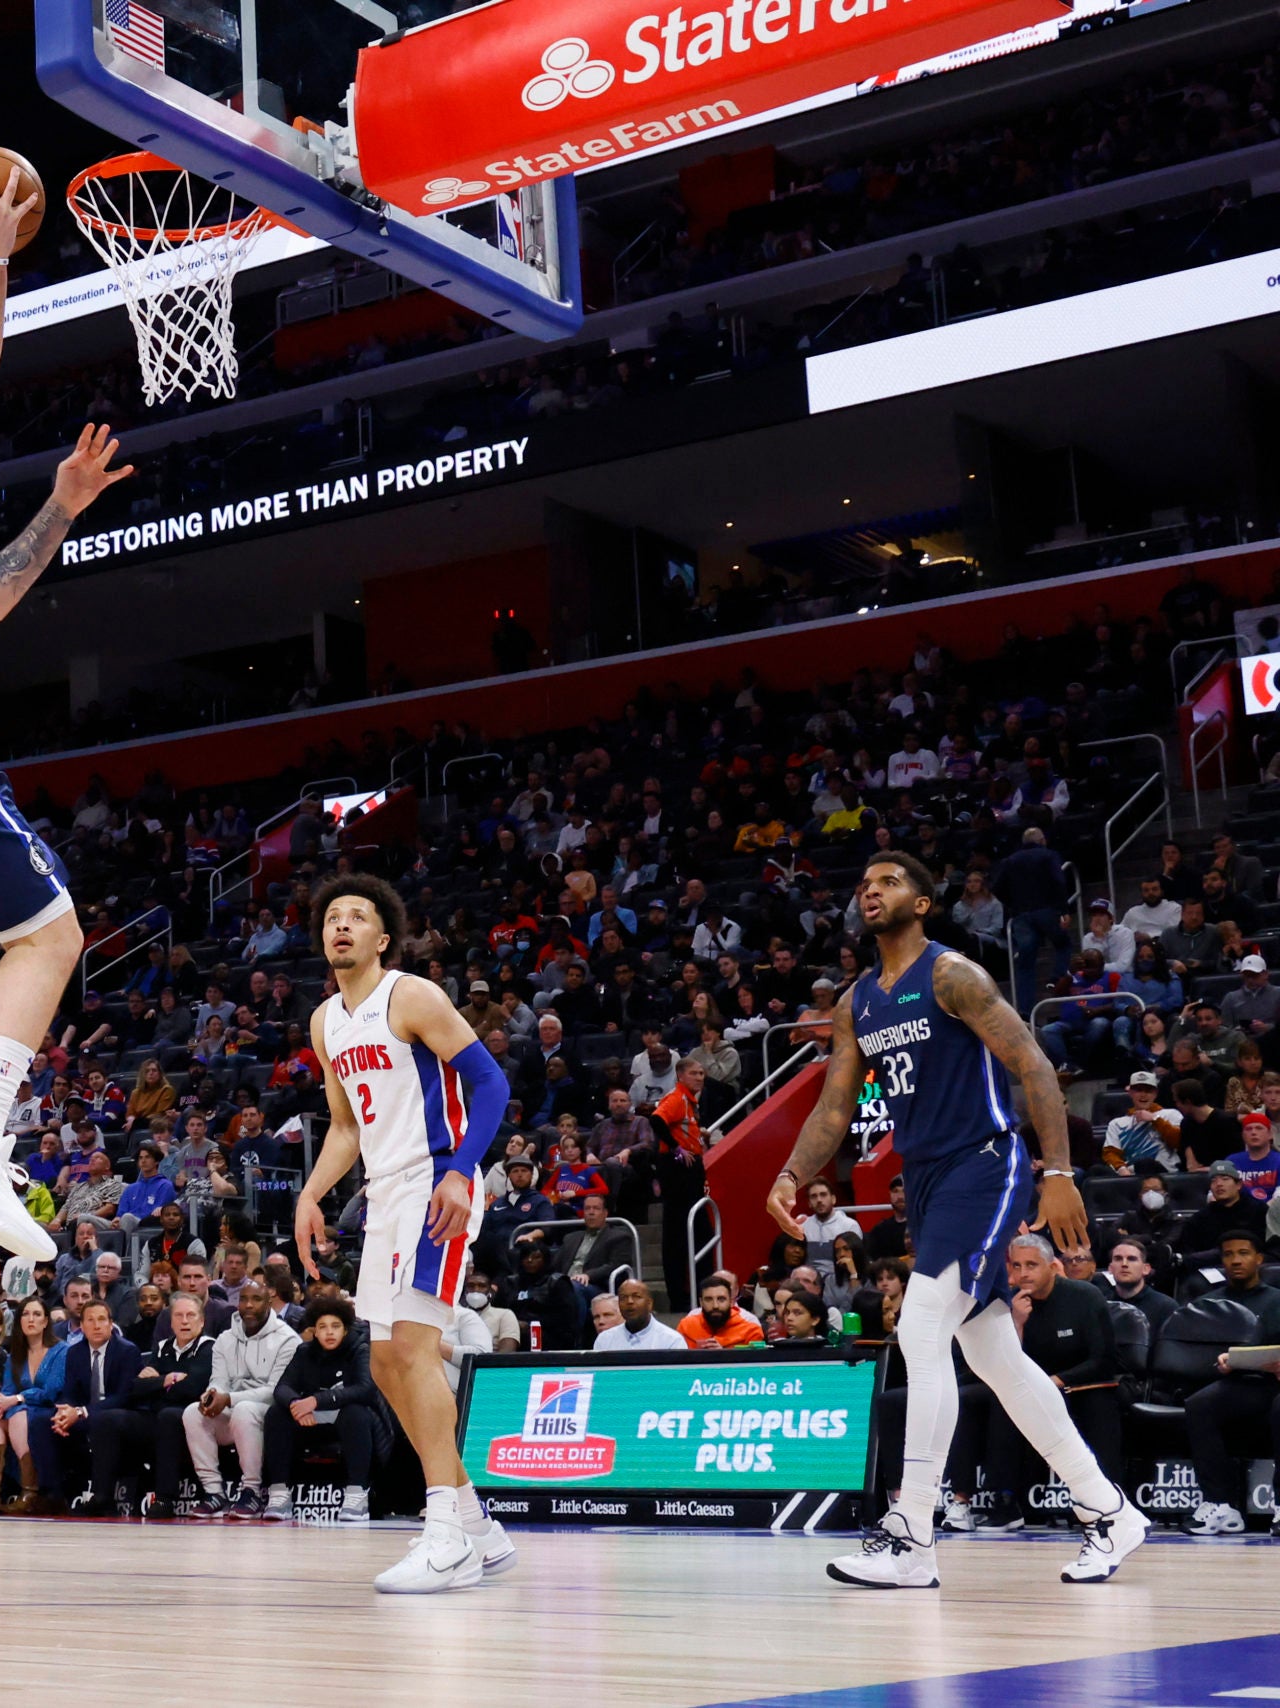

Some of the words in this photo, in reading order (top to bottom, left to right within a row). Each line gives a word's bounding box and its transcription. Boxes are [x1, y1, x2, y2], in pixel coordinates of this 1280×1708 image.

[623, 0, 913, 84] StateFa
[12, 303, 50, 322] Property
[52, 287, 105, 310] Restoration
[61, 512, 204, 566] RESTORING
[210, 490, 291, 534] MORE
[296, 472, 369, 515] THAN
[376, 436, 530, 496] PROPERTY
[897, 990, 921, 1005] chime
[331, 1044, 394, 1082] PISTONS
[882, 1051, 916, 1098] 32
[357, 1083, 376, 1126] 2
[688, 1378, 777, 1396] Available
[782, 1378, 803, 1396] at
[532, 1417, 577, 1436] Hill's
[637, 1409, 695, 1439] PET
[701, 1409, 849, 1440] SUPPLIES
[496, 1447, 563, 1461] SCIENCE
[567, 1447, 606, 1461] DIET
[1155, 1463, 1199, 1488] Litt
[297, 1483, 342, 1505] Little
[486, 1497, 529, 1512] Caesars
[551, 1498, 582, 1514] Little
[582, 1499, 628, 1515] Caesars
[1136, 1483, 1204, 1509] Caesa
[655, 1500, 687, 1516] Little
[687, 1501, 734, 1517] Caesars
